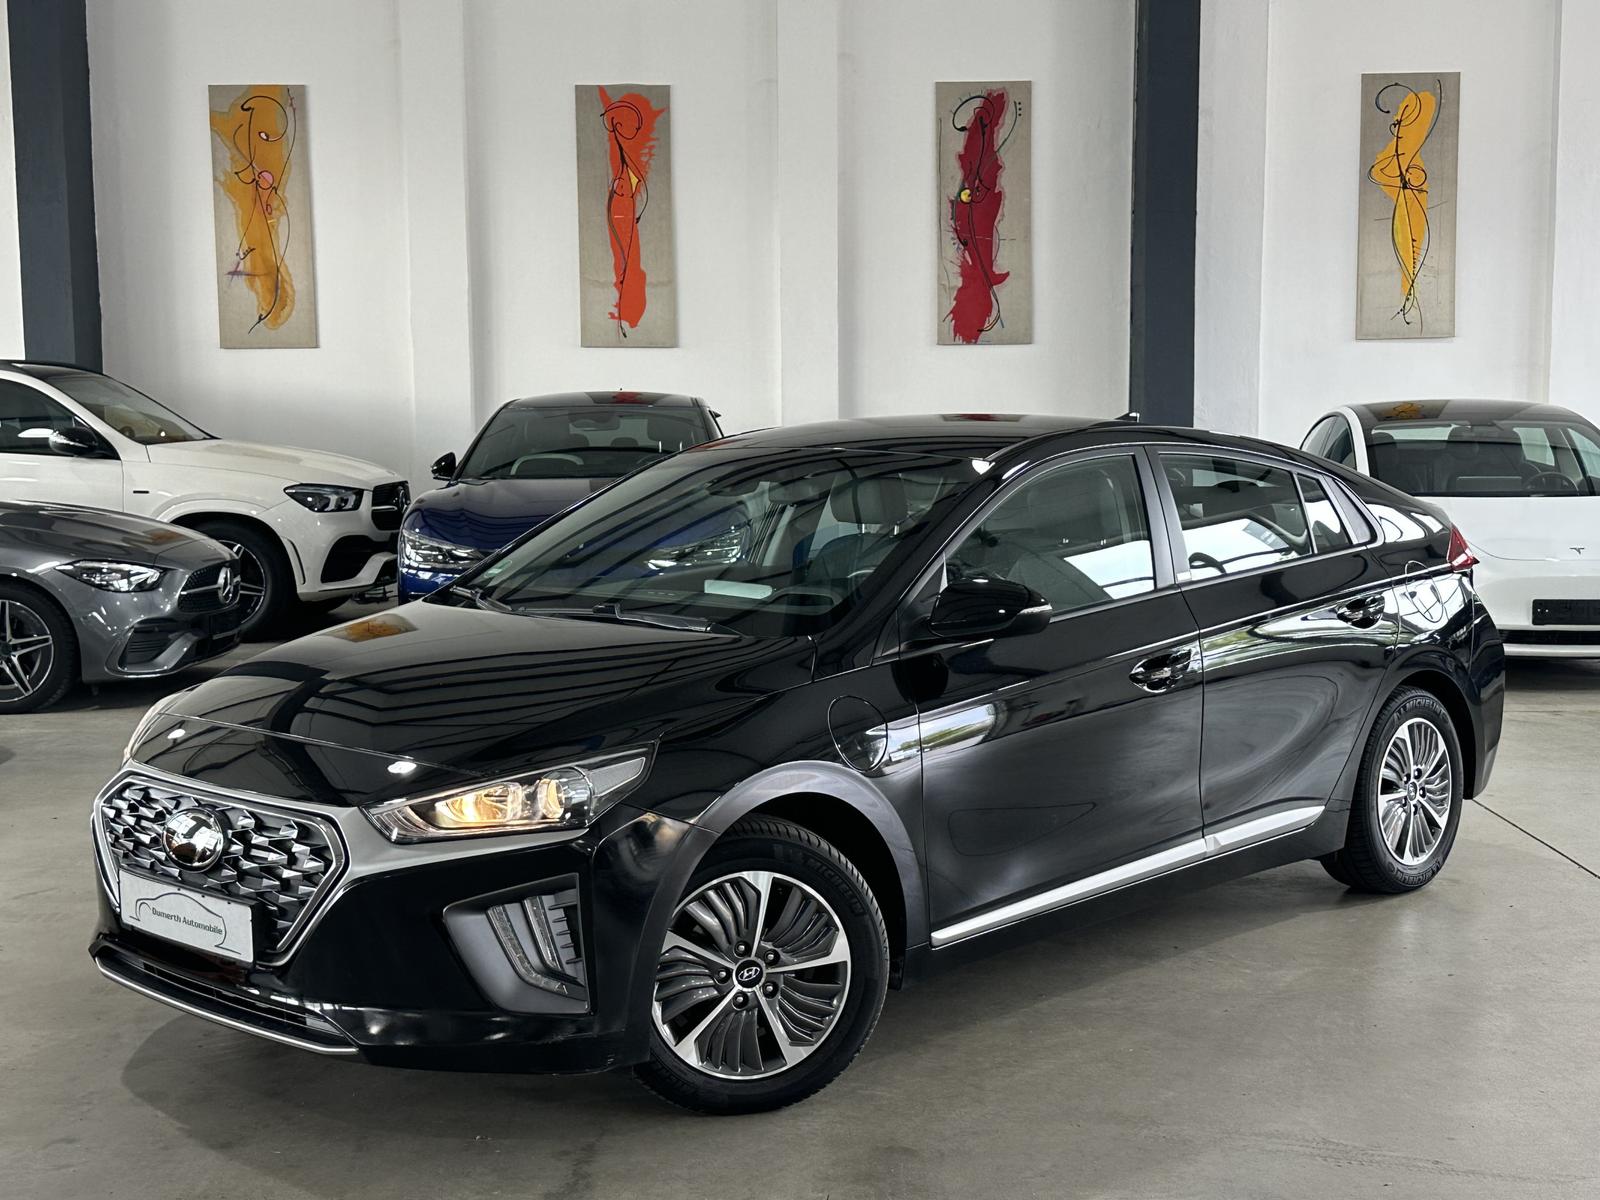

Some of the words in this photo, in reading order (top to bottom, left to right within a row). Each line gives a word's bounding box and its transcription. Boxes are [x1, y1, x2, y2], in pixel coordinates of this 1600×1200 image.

[1405, 698, 1441, 715] MICHELIN
[804, 855, 867, 917] MICHELIN
[182, 916, 223, 935] Automobile
